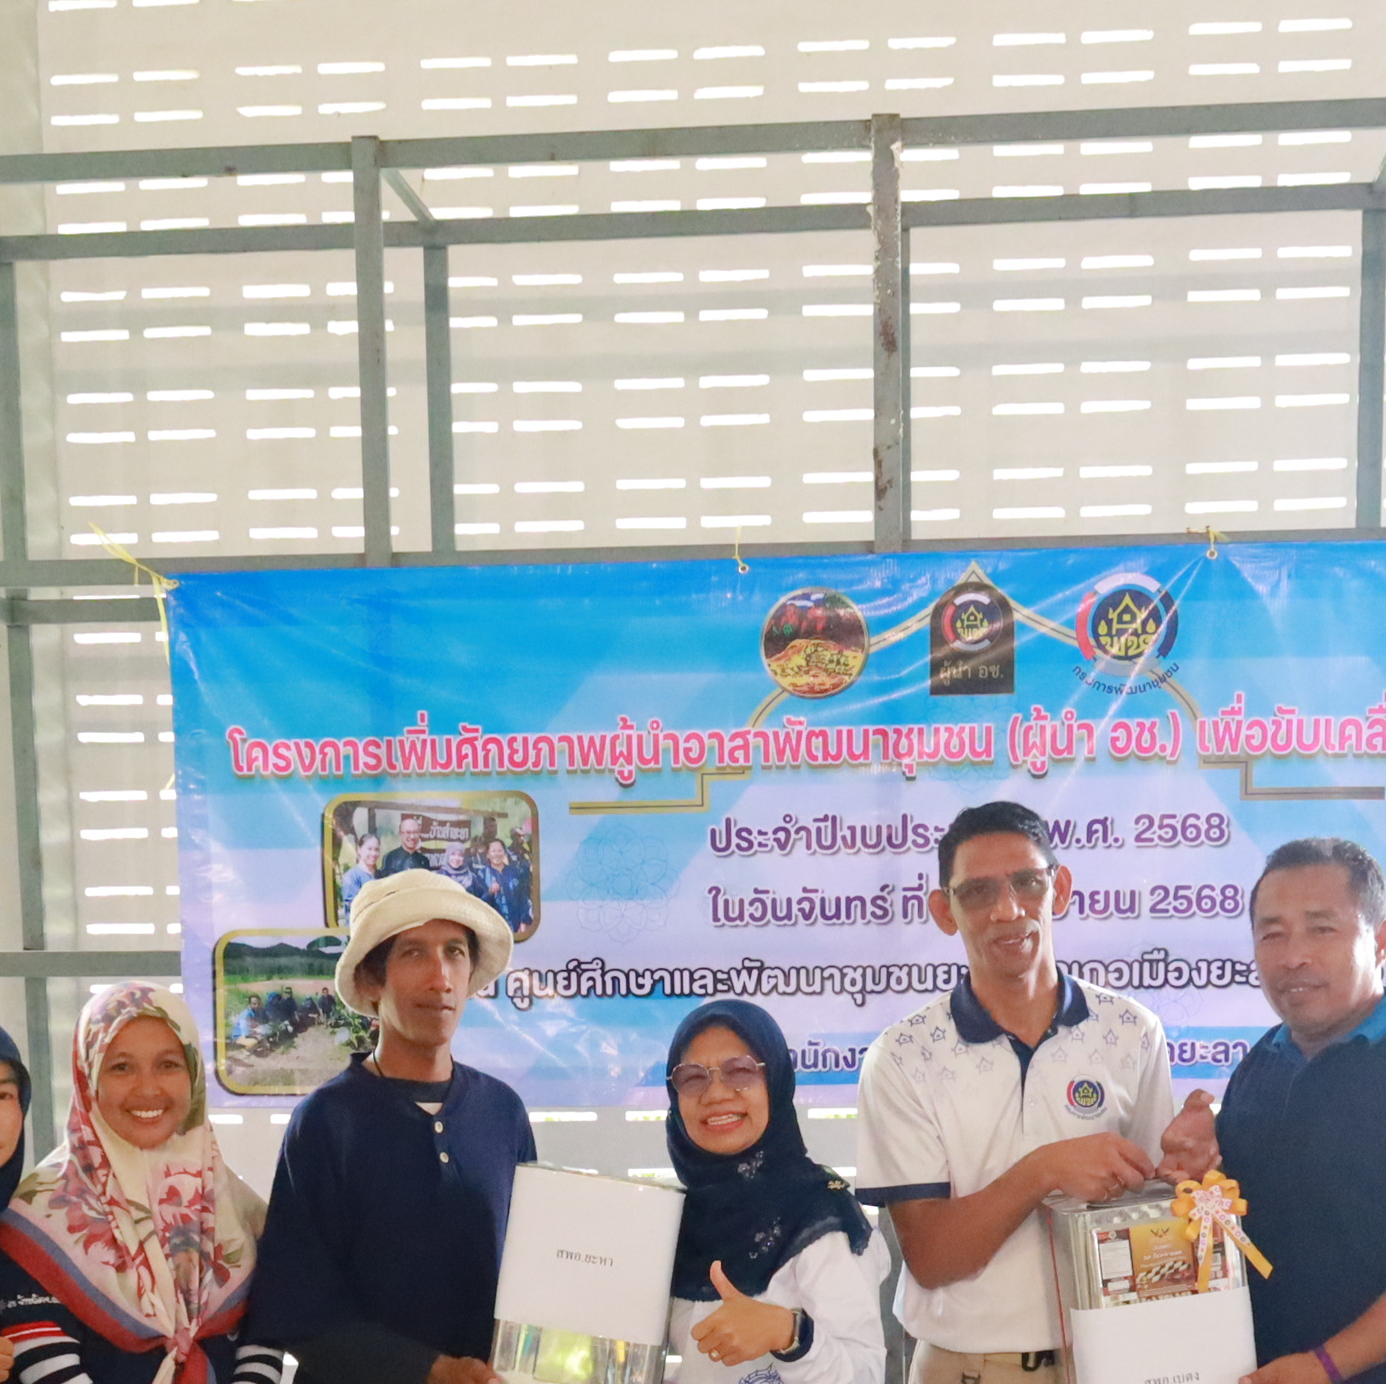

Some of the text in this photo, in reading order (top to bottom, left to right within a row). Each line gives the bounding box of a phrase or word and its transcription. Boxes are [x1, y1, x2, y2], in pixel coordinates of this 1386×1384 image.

[227, 711, 994, 783] โครงการเพิ่มศักยภาพผู้นำอาสาพัฒนาชุมชน
[1008, 706, 1095, 774] (ผู้นำ
[1110, 711, 1180, 759] อช.)
[709, 813, 947, 852] ประจำปีงบประ
[1134, 813, 1227, 844] 2568
[708, 872, 1240, 923] ในวันจันทร์ ที่ ายน 2568
